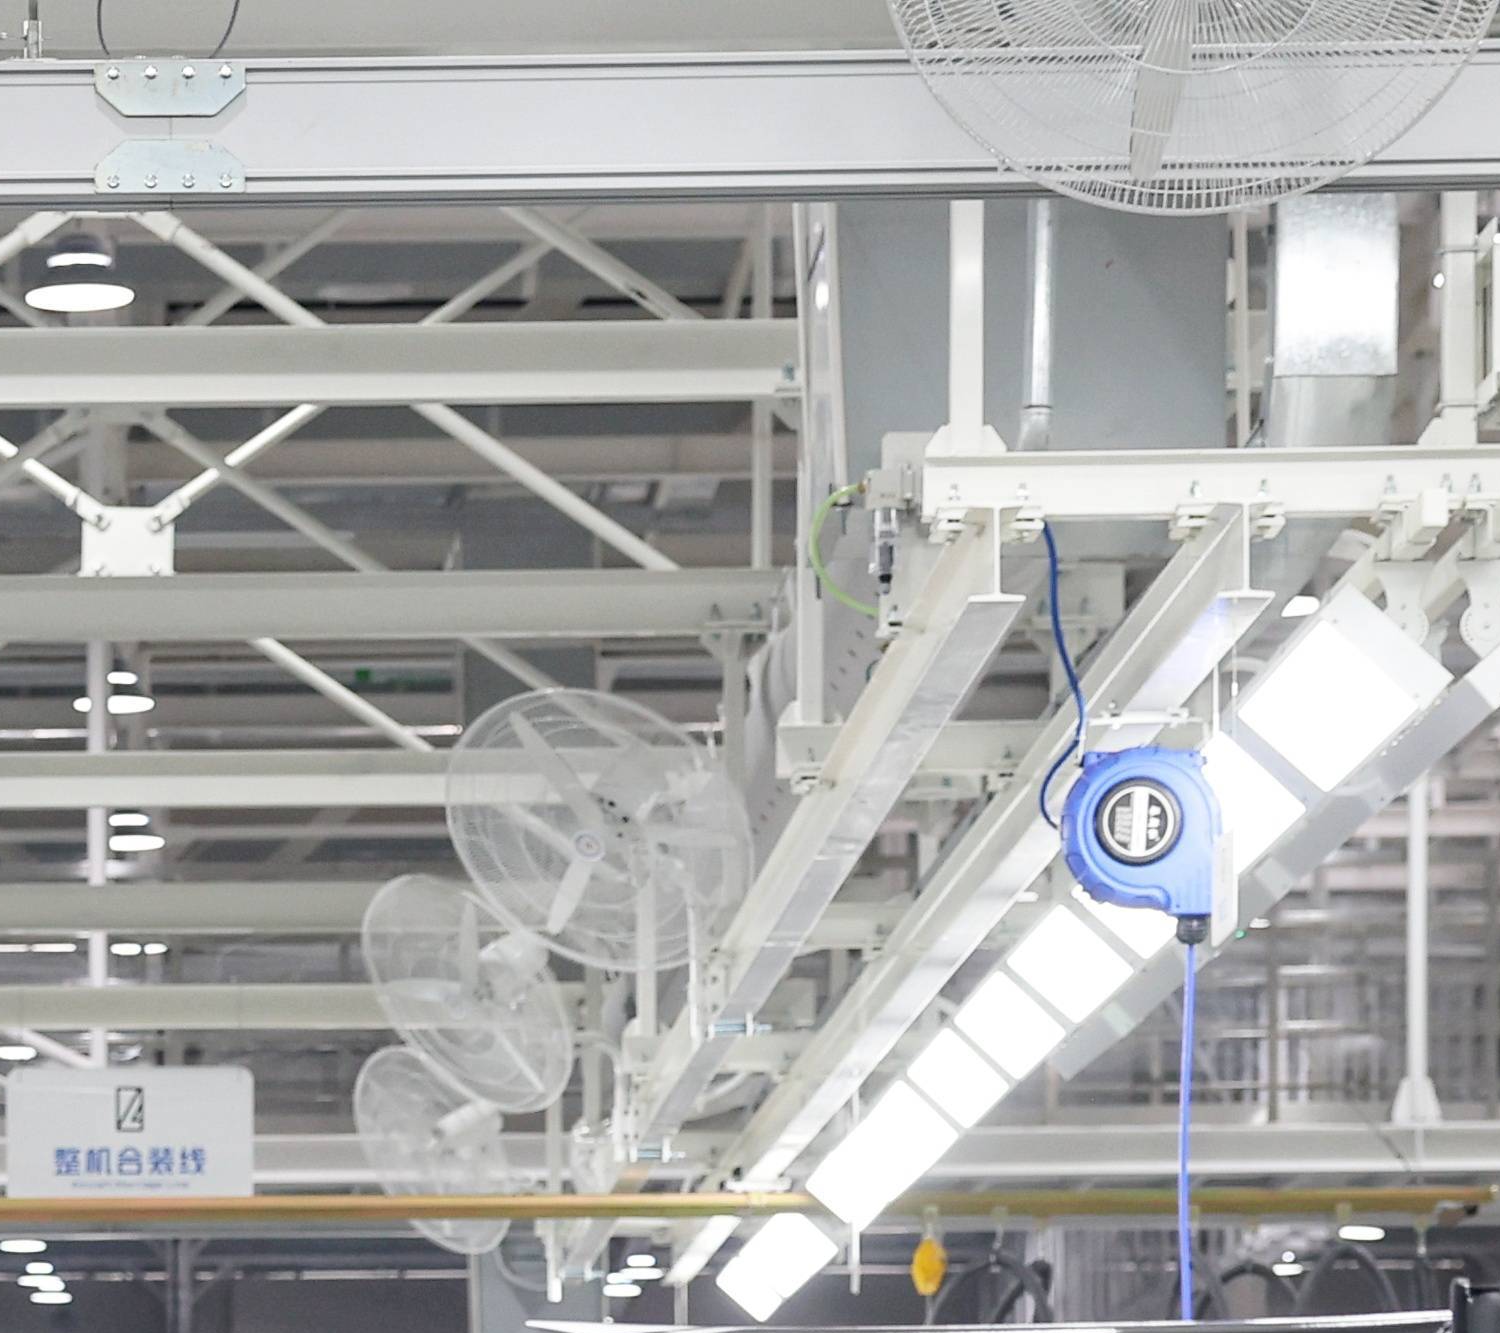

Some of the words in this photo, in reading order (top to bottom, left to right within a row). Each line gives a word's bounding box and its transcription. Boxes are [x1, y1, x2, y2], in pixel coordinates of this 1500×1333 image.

[55, 1146, 206, 1176] 整机合装线
